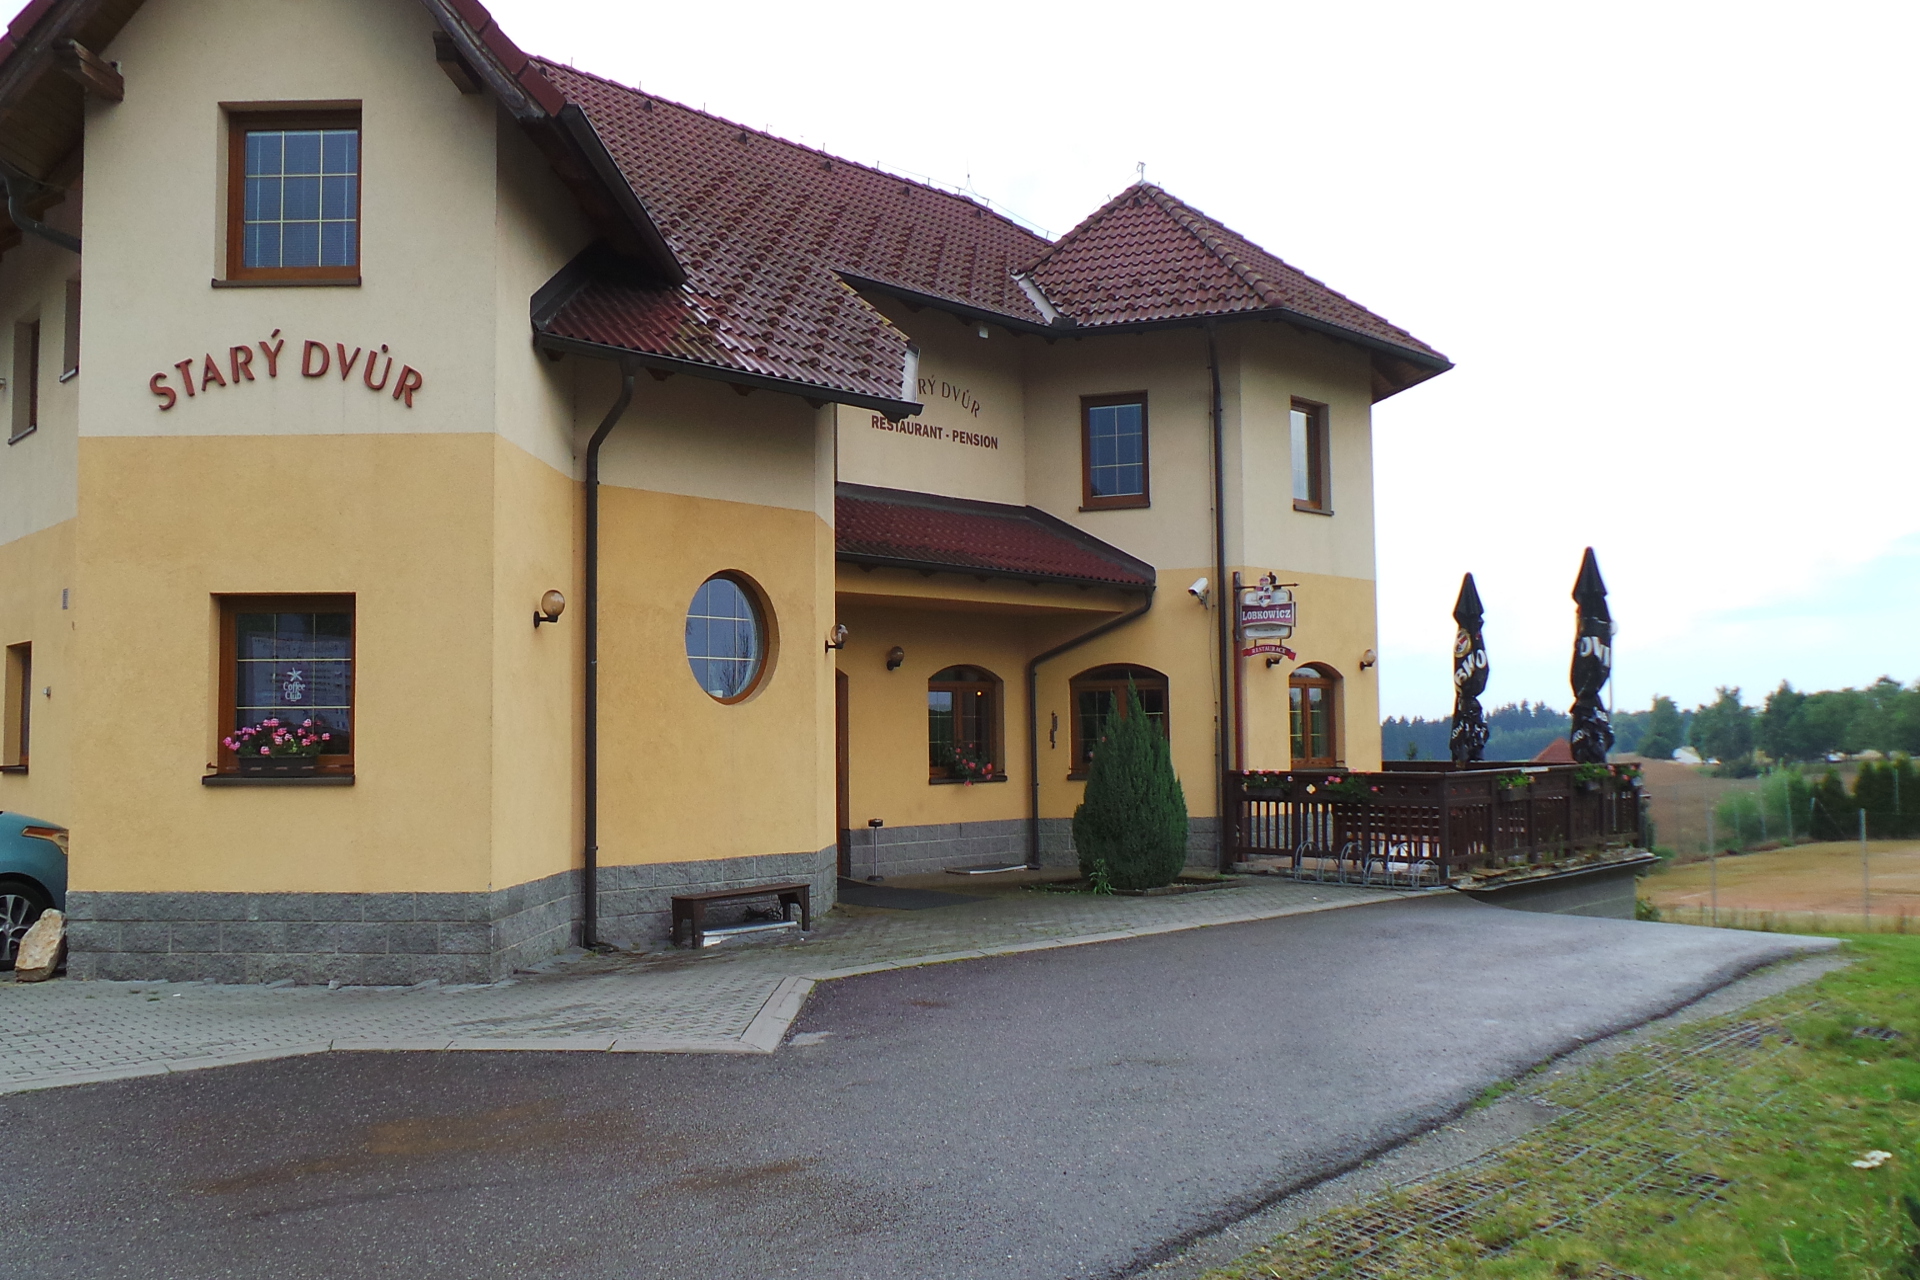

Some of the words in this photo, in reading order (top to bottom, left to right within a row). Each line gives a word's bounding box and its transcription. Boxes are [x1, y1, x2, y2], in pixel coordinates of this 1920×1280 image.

[149, 328, 285, 411] STARÝ
[301, 339, 423, 408] DVŮR
[952, 430, 998, 449] PENSION
[1242, 608, 1291, 620] LOBKOWICZ
[283, 681, 306, 693] Coffee
[284, 691, 302, 700] Club
